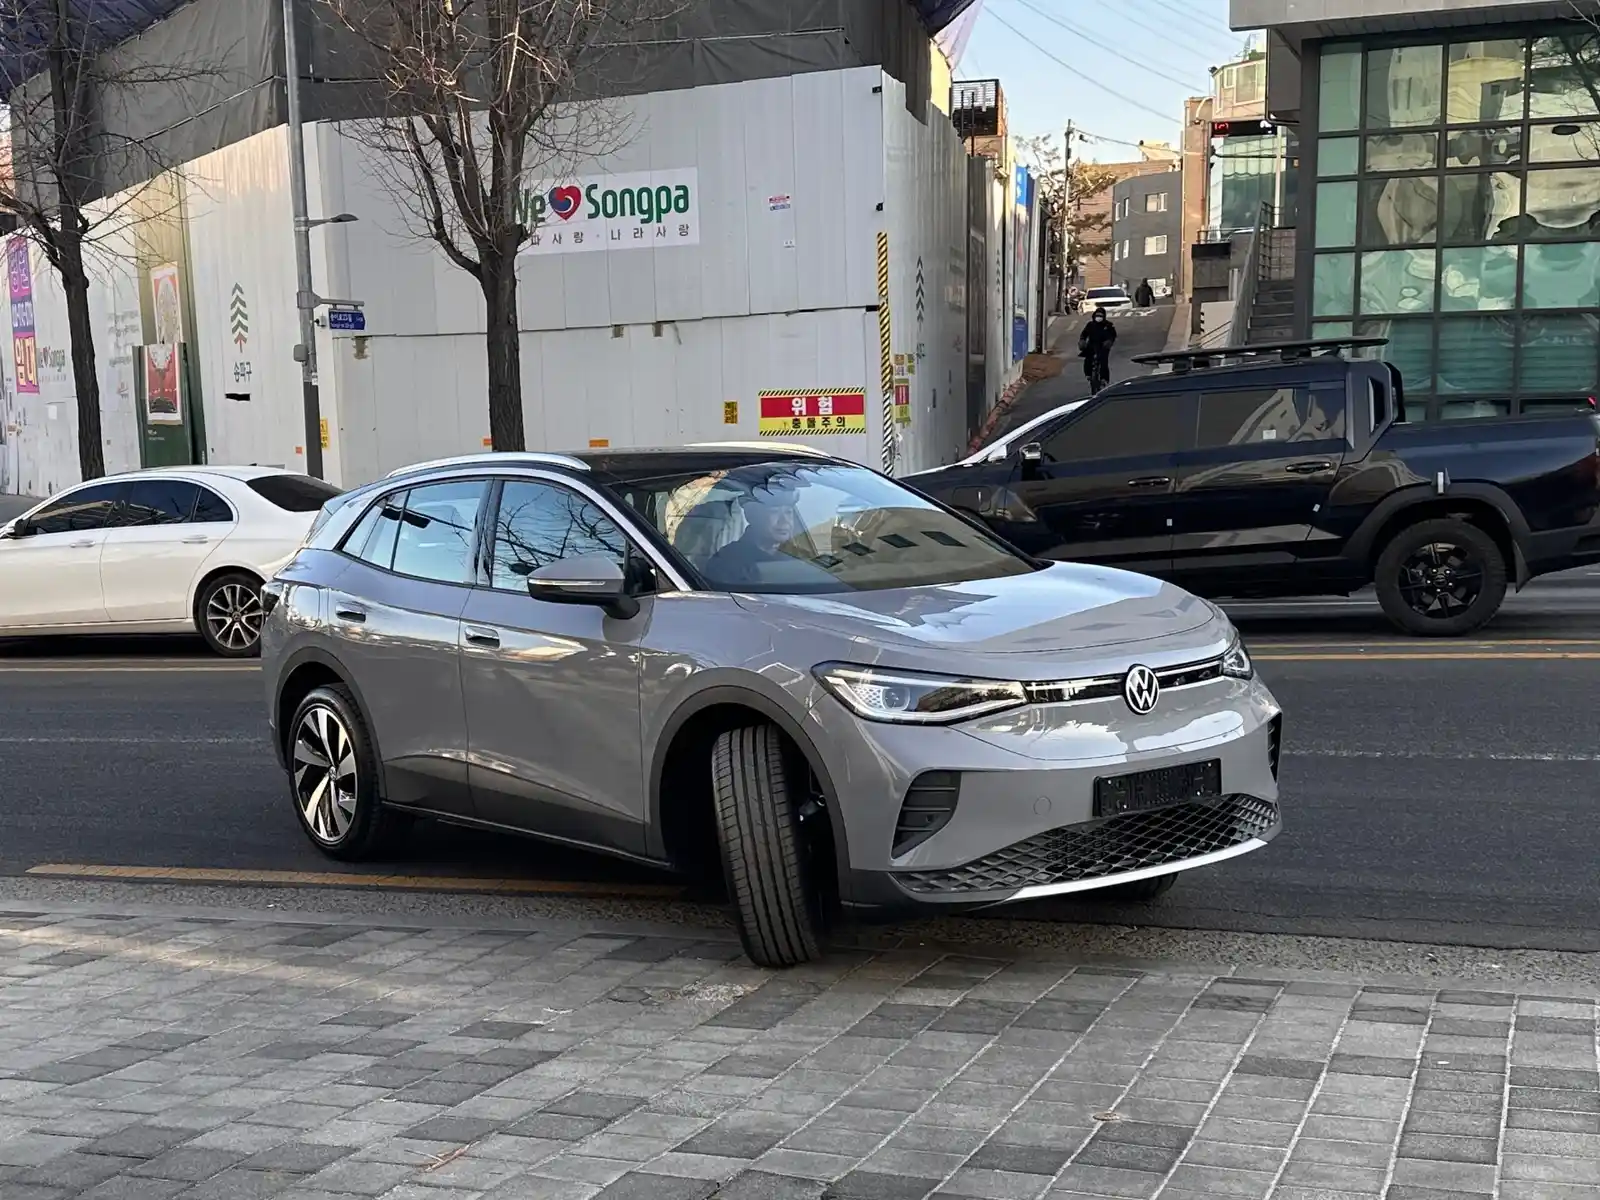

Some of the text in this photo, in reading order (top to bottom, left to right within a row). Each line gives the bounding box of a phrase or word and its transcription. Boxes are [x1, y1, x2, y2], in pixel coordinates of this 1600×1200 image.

[585, 184, 689, 224] Songpa
[531, 223, 690, 247] 파사랑 나라사랑
[234, 361, 252, 383] 송파구
[791, 396, 833, 416] 위험
